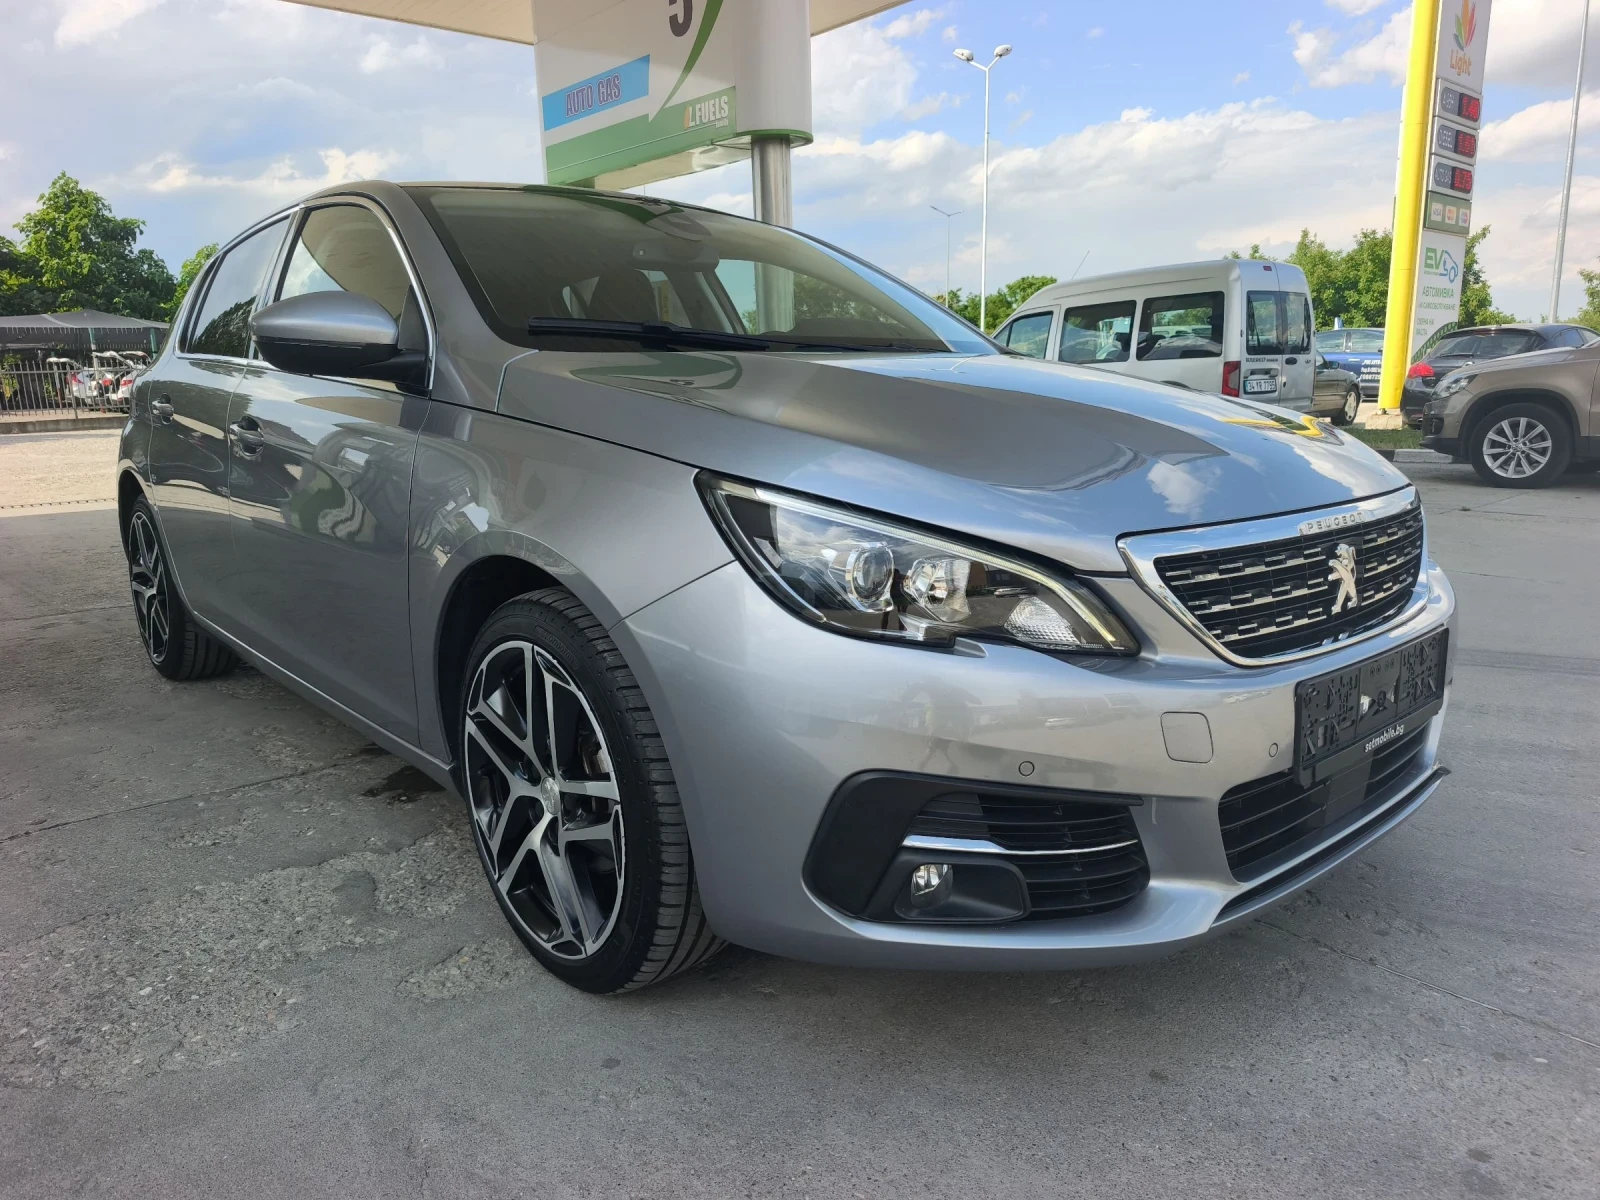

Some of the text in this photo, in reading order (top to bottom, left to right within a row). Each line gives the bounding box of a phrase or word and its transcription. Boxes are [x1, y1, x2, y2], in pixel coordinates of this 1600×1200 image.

[1450, 49, 1472, 76] Light
[565, 72, 621, 118] AUTO GAS
[1433, 208, 1442, 217] VISA
[1424, 247, 1445, 270] EV
[1422, 286, 1454, 298] АВТОМИВКА
[1307, 512, 1362, 532] PEUGEOT
